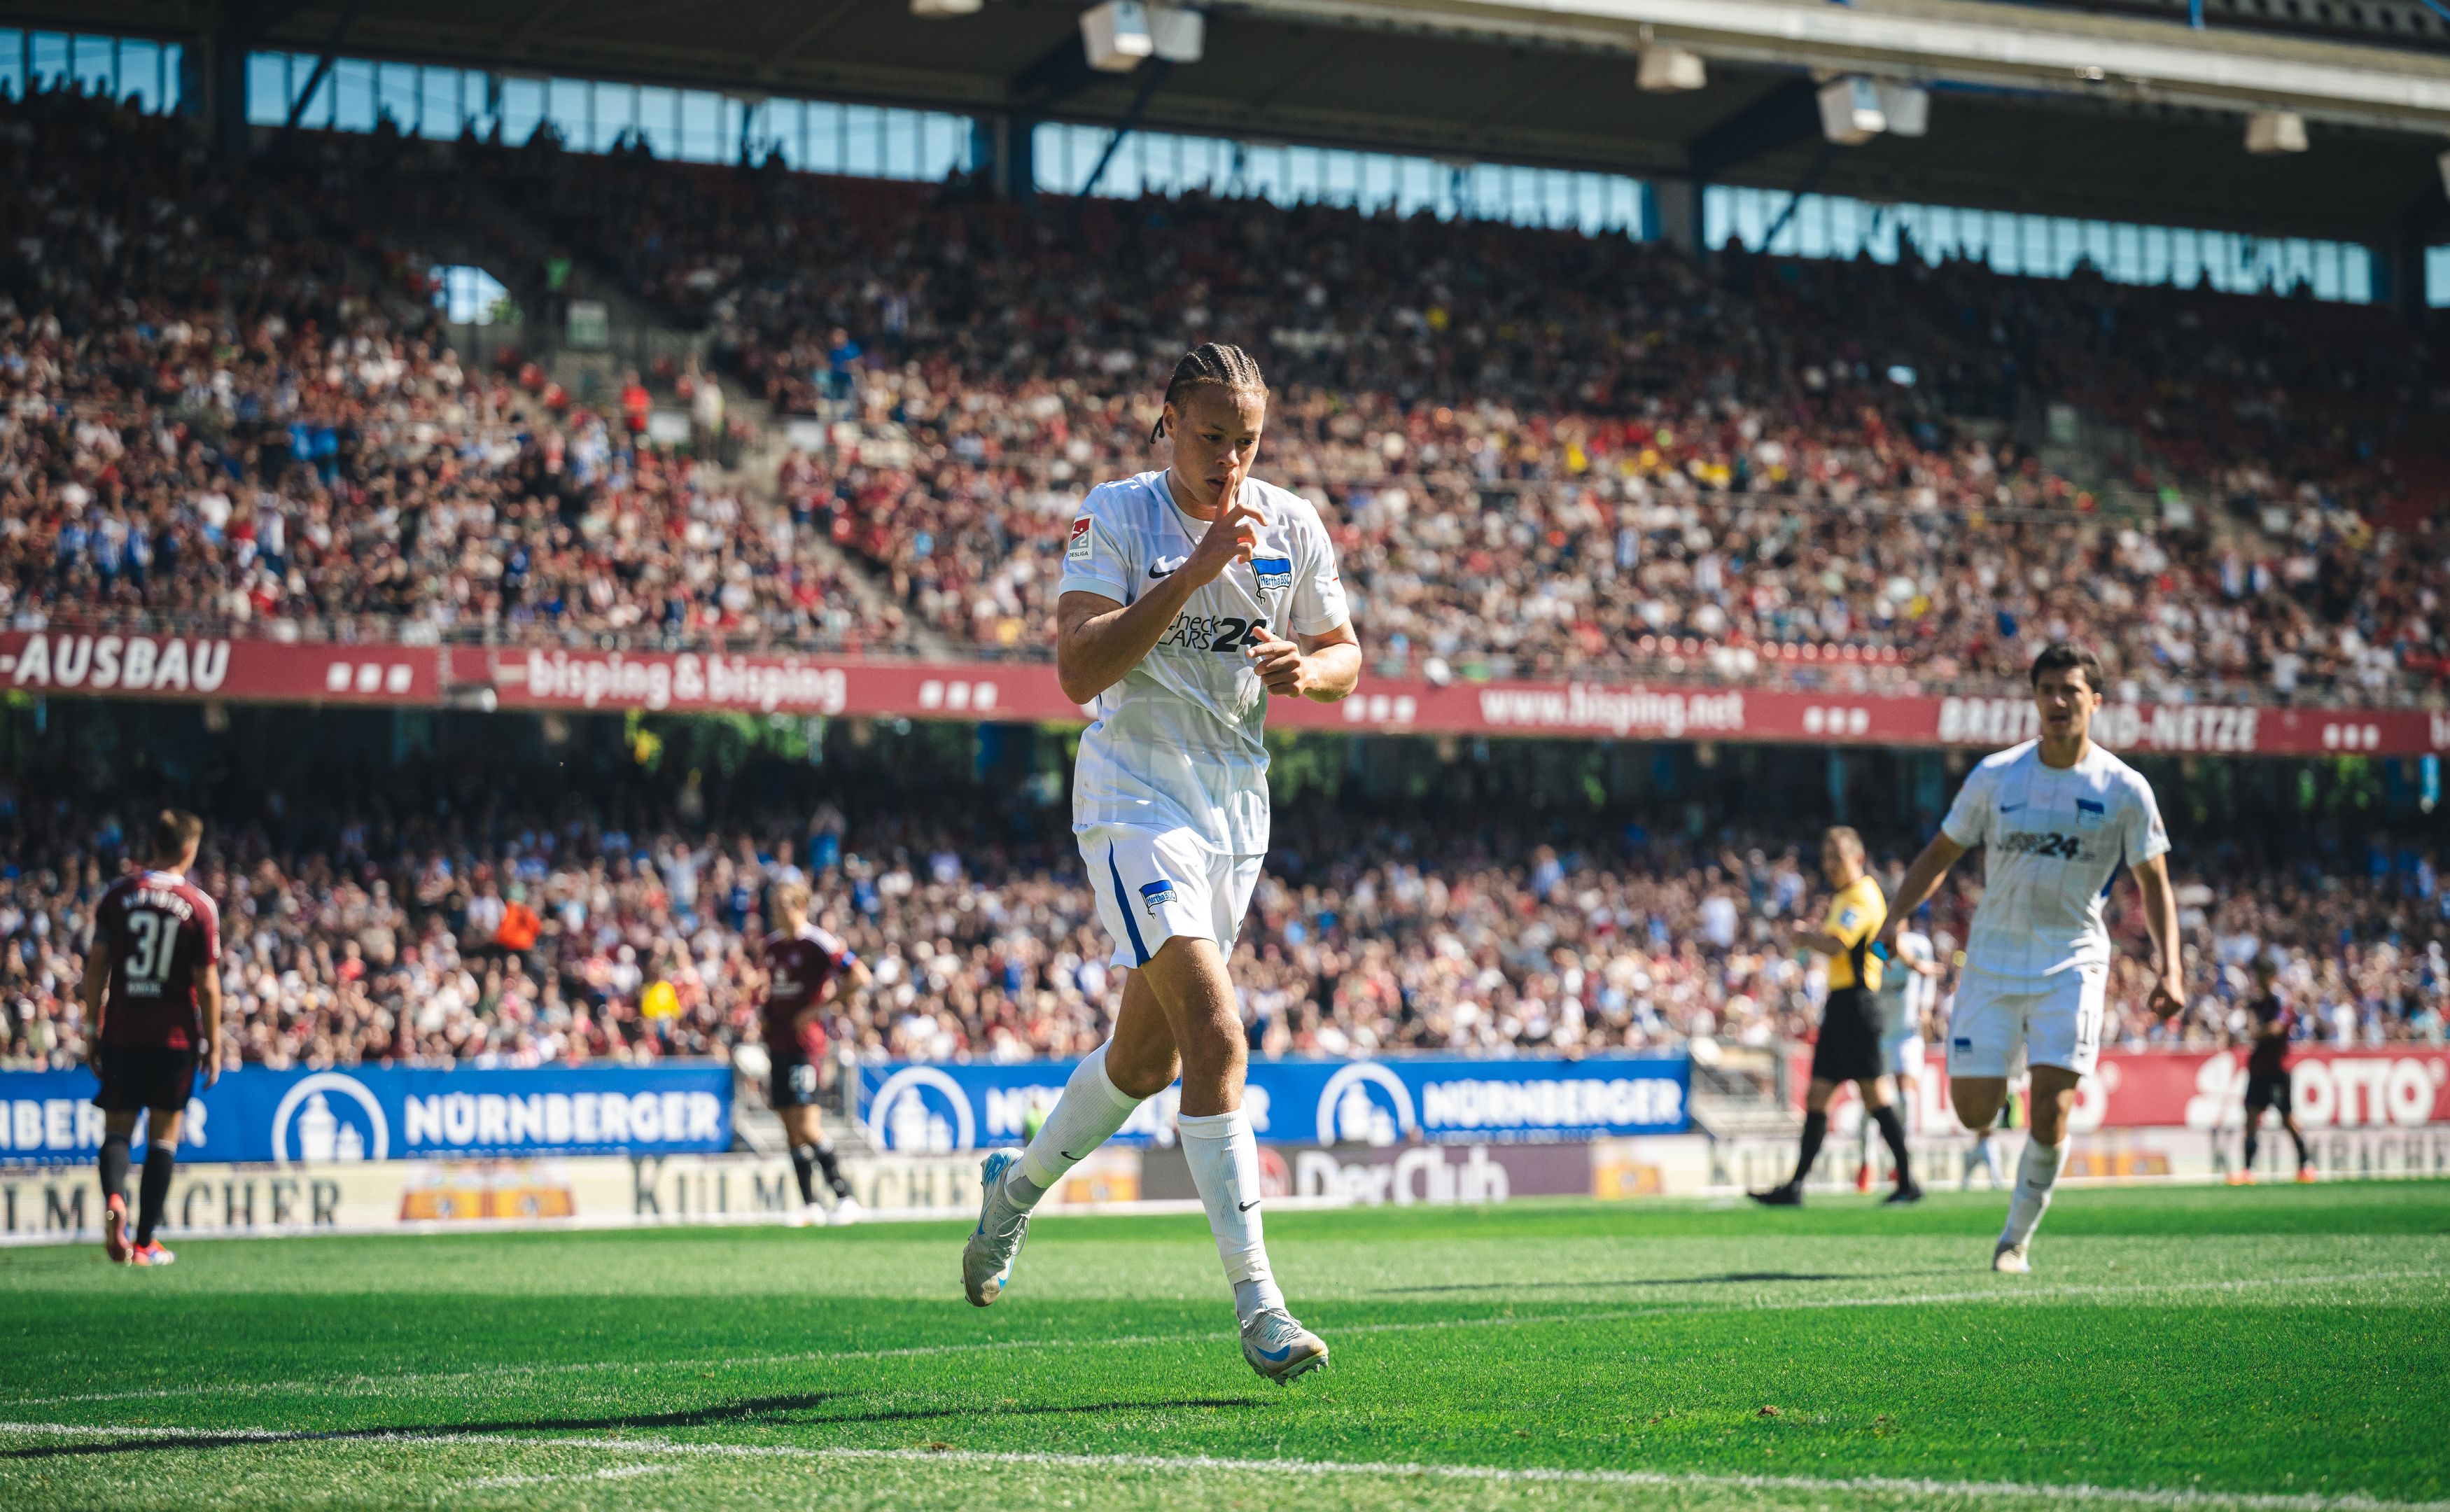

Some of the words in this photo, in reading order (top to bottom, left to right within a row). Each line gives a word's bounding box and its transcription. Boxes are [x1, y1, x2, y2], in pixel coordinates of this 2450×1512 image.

[1079, 532, 1087, 547] 2
[1157, 629, 1212, 650] ARS
[1168, 611, 1222, 634] heck
[126, 909, 178, 982] 31
[2260, 1056, 2436, 1128] OTTO
[405, 1090, 722, 1146] NÜRNBERGER
